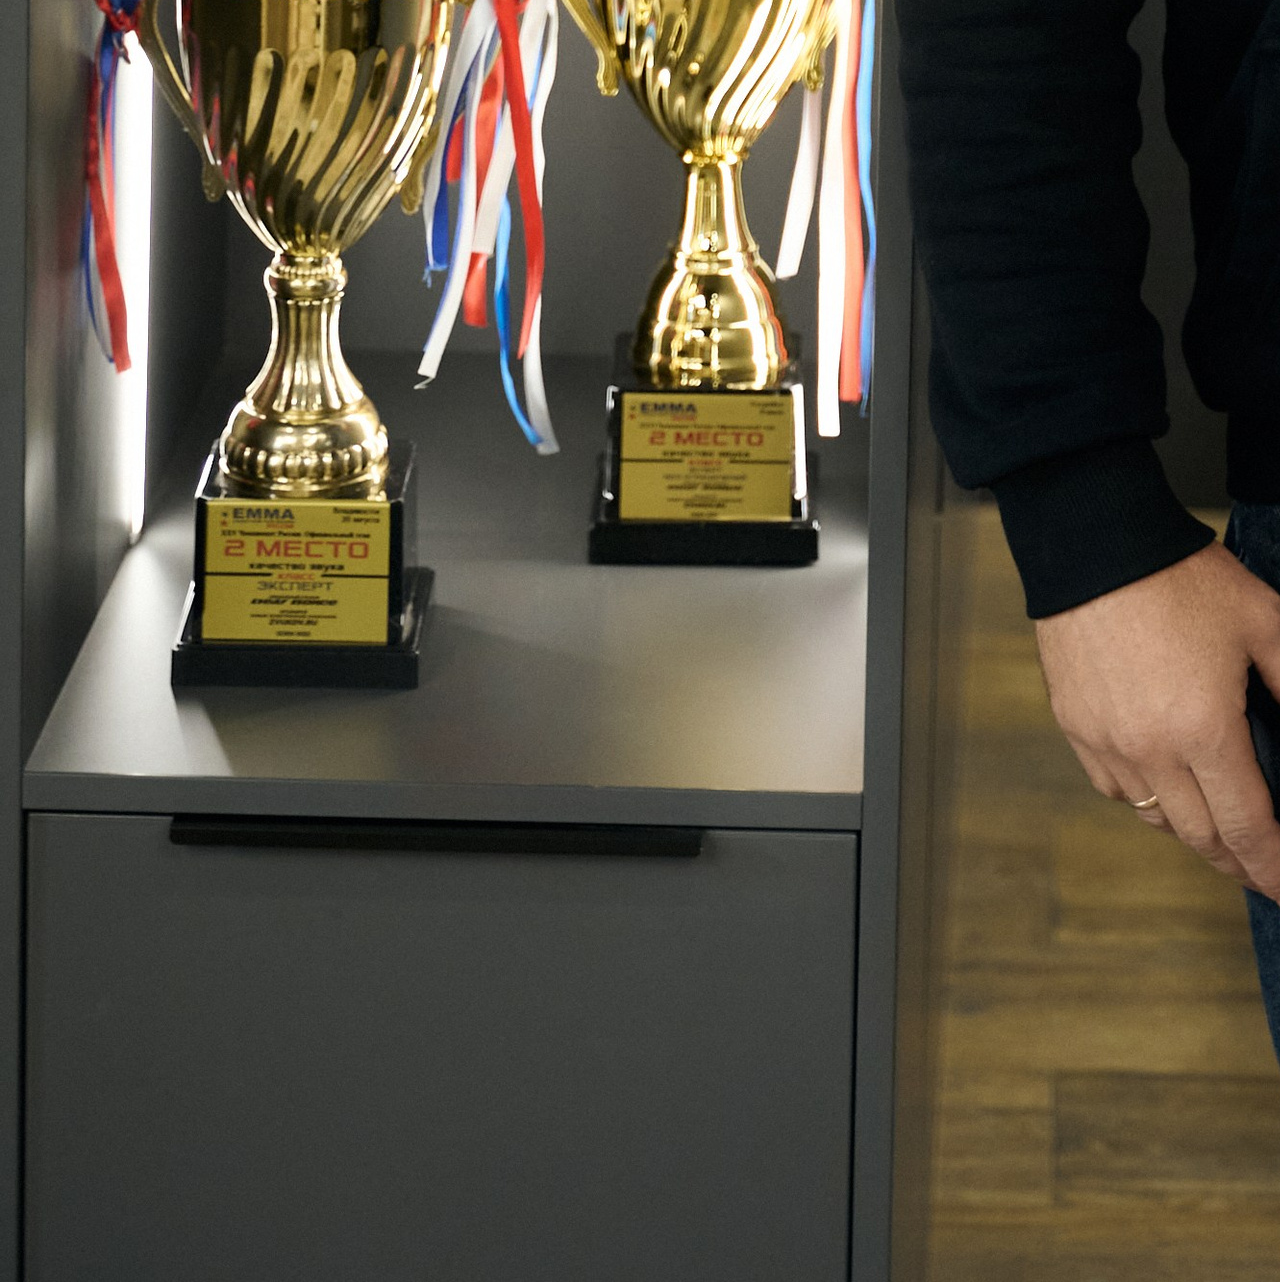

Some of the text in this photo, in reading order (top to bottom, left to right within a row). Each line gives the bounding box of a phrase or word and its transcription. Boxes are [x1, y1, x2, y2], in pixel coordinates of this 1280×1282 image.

[640, 403, 697, 414] EMMA
[649, 431, 764, 446] 2 МЕСТО
[233, 508, 294, 519] EMMA
[225, 540, 369, 558] 2 МЕСТО
[249, 563, 344, 572] качество звука
[257, 581, 334, 591] ЭКСПЕРТ
